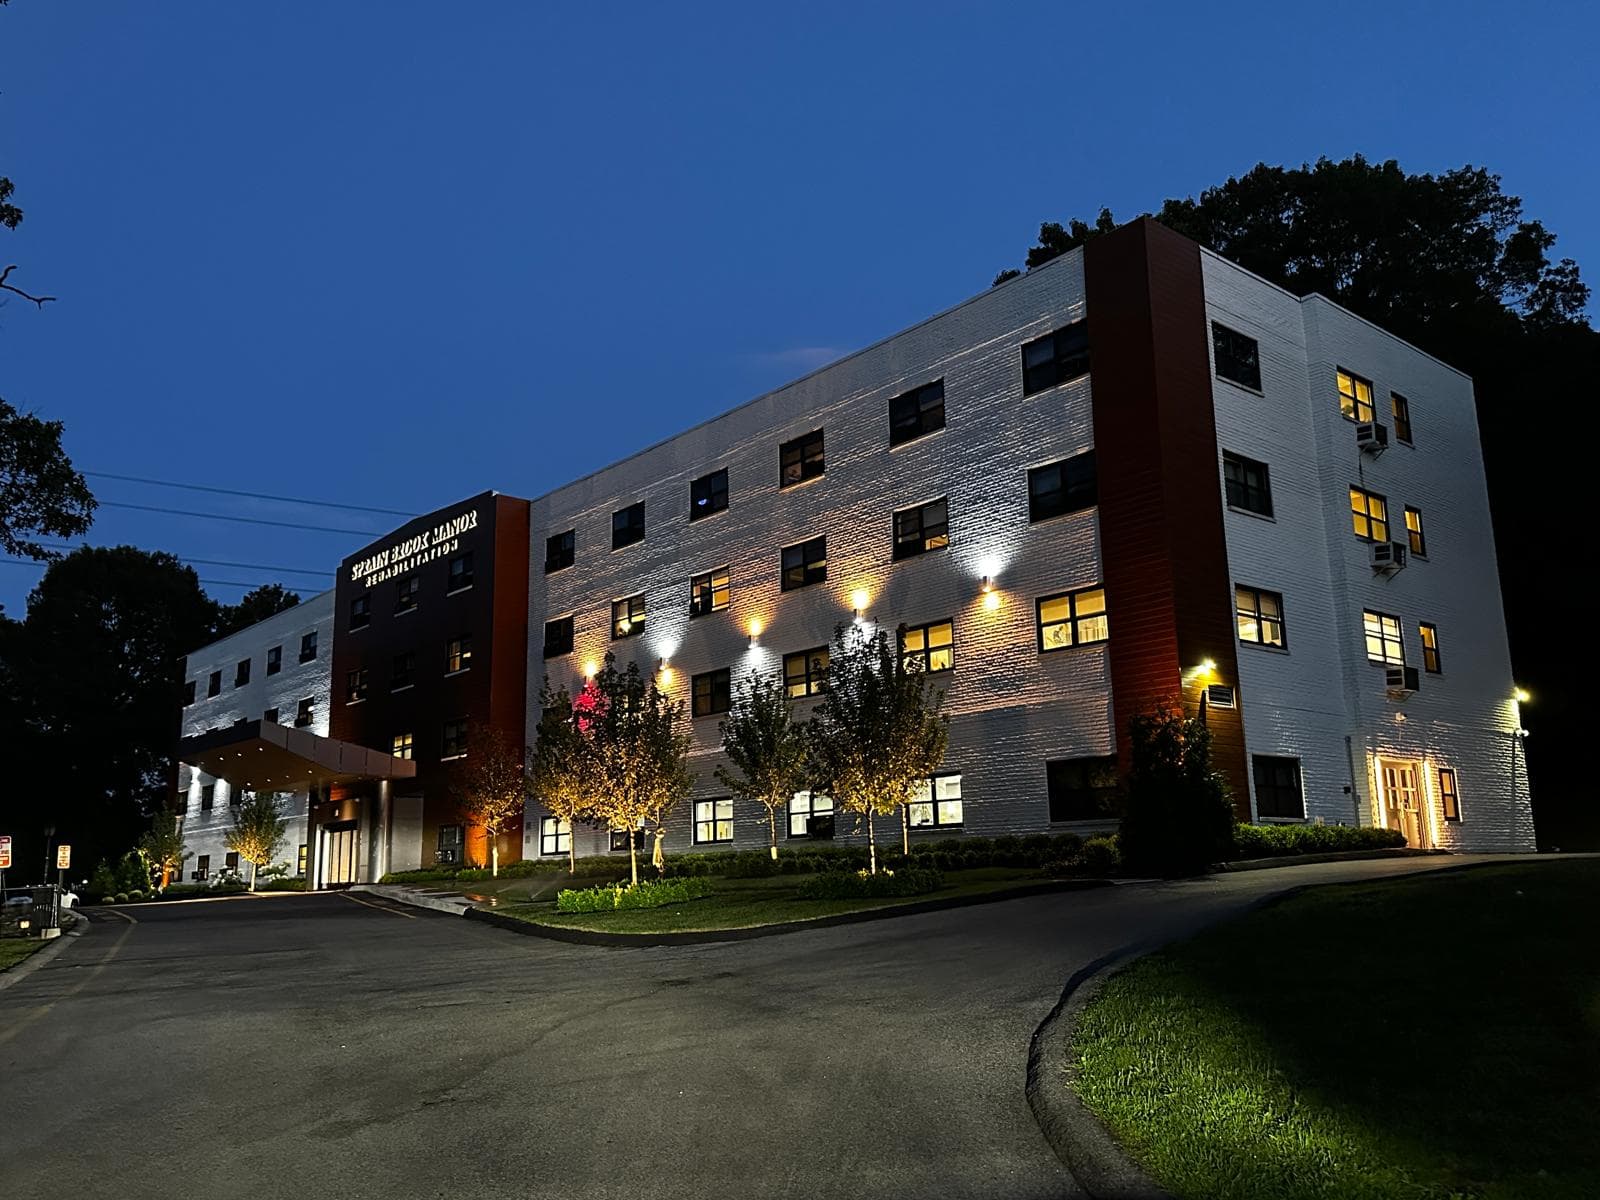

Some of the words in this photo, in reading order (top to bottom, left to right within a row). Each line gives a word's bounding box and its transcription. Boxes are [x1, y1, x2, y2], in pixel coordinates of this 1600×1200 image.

[391, 531, 430, 563] BROOK
[432, 510, 478, 545] MANOR
[365, 538, 459, 588] REHABILITATION
